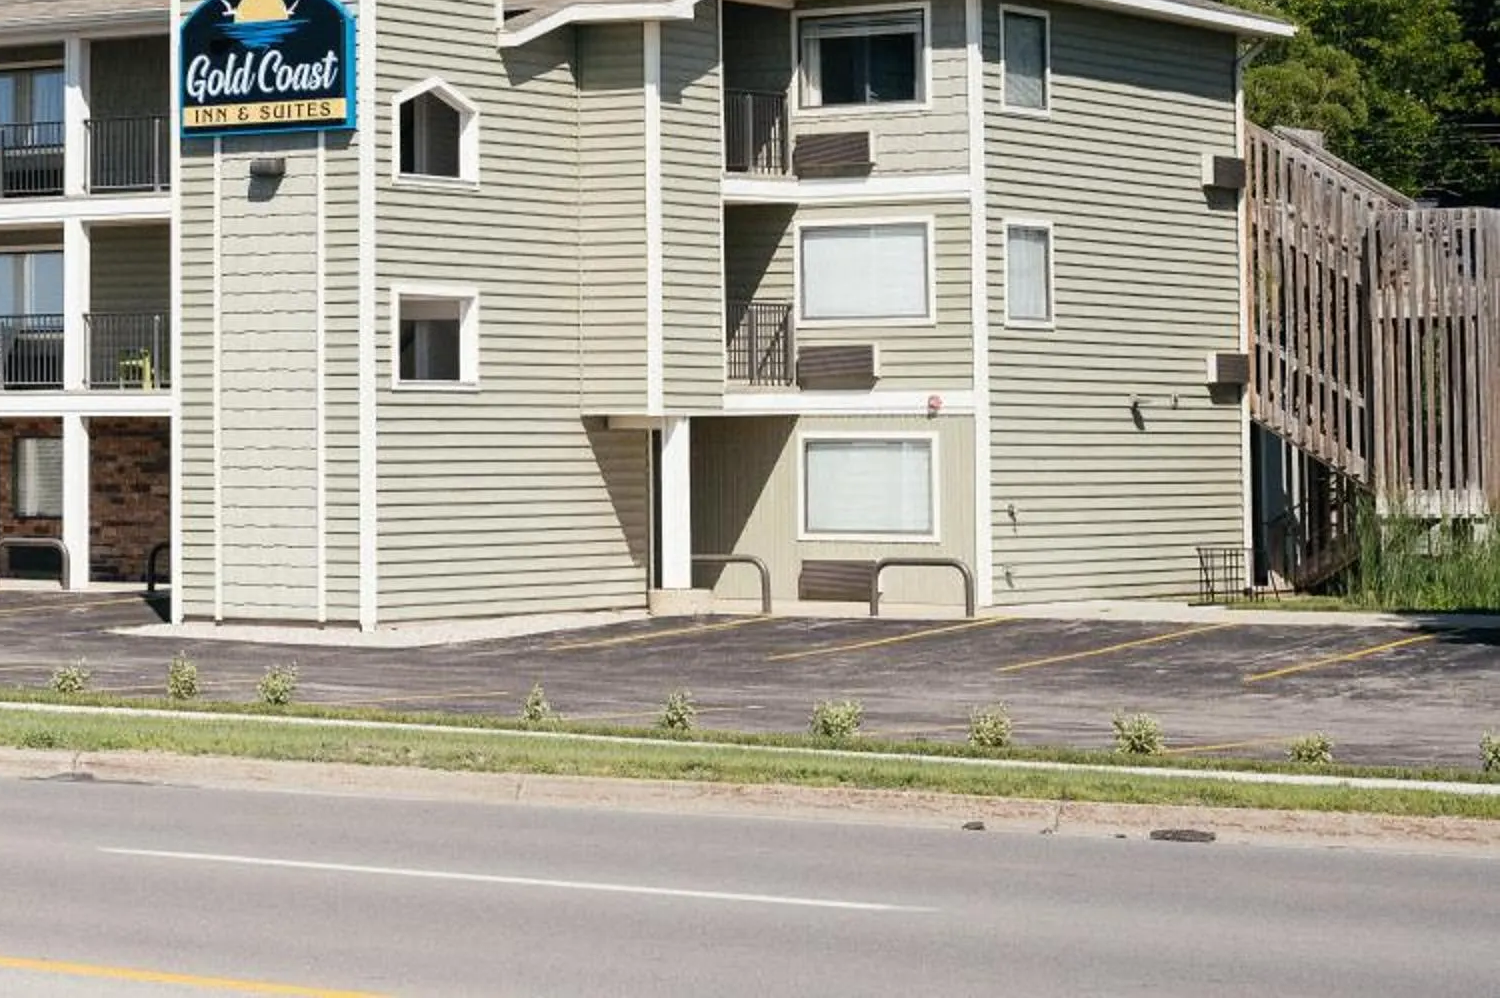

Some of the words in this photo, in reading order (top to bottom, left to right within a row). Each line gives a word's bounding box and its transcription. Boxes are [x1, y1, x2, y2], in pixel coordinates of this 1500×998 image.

[186, 52, 255, 103] Gold
[258, 49, 339, 93] Coast
[195, 108, 227, 124] INN
[237, 106, 249, 121] &
[259, 102, 331, 120] SUITES
